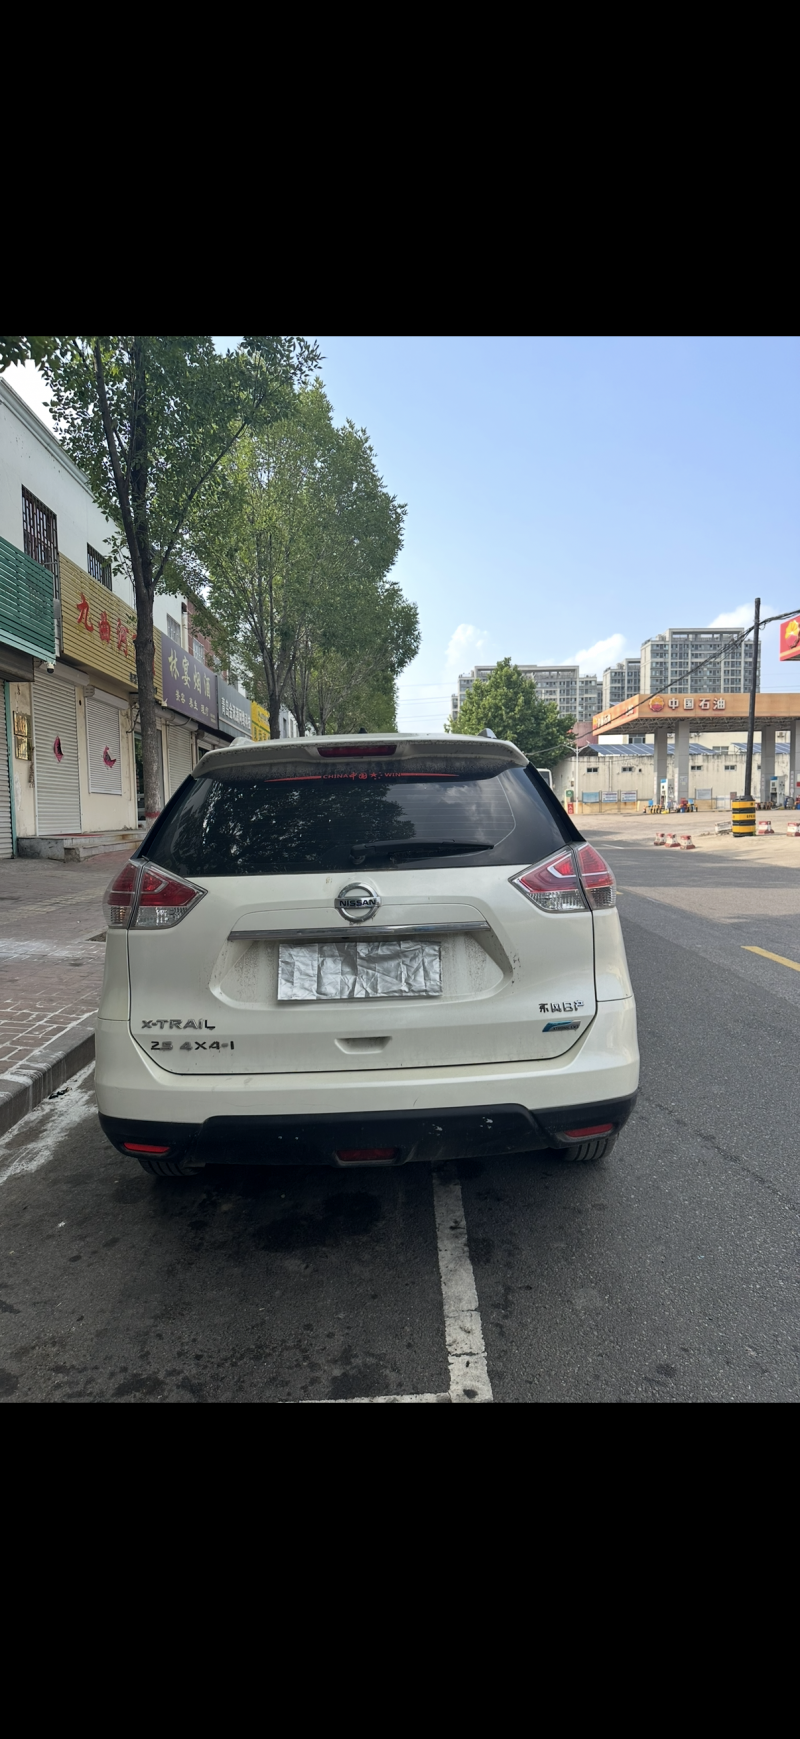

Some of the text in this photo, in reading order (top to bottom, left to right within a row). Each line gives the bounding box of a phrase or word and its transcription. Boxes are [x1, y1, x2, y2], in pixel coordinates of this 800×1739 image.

[668, 697, 726, 711] 中国石油
[349, 771, 368, 781] 中国
[339, 899, 376, 907] NISSAN
[538, 1000, 585, 1013] 东风日产
[141, 1018, 216, 1031] X-TRAIL
